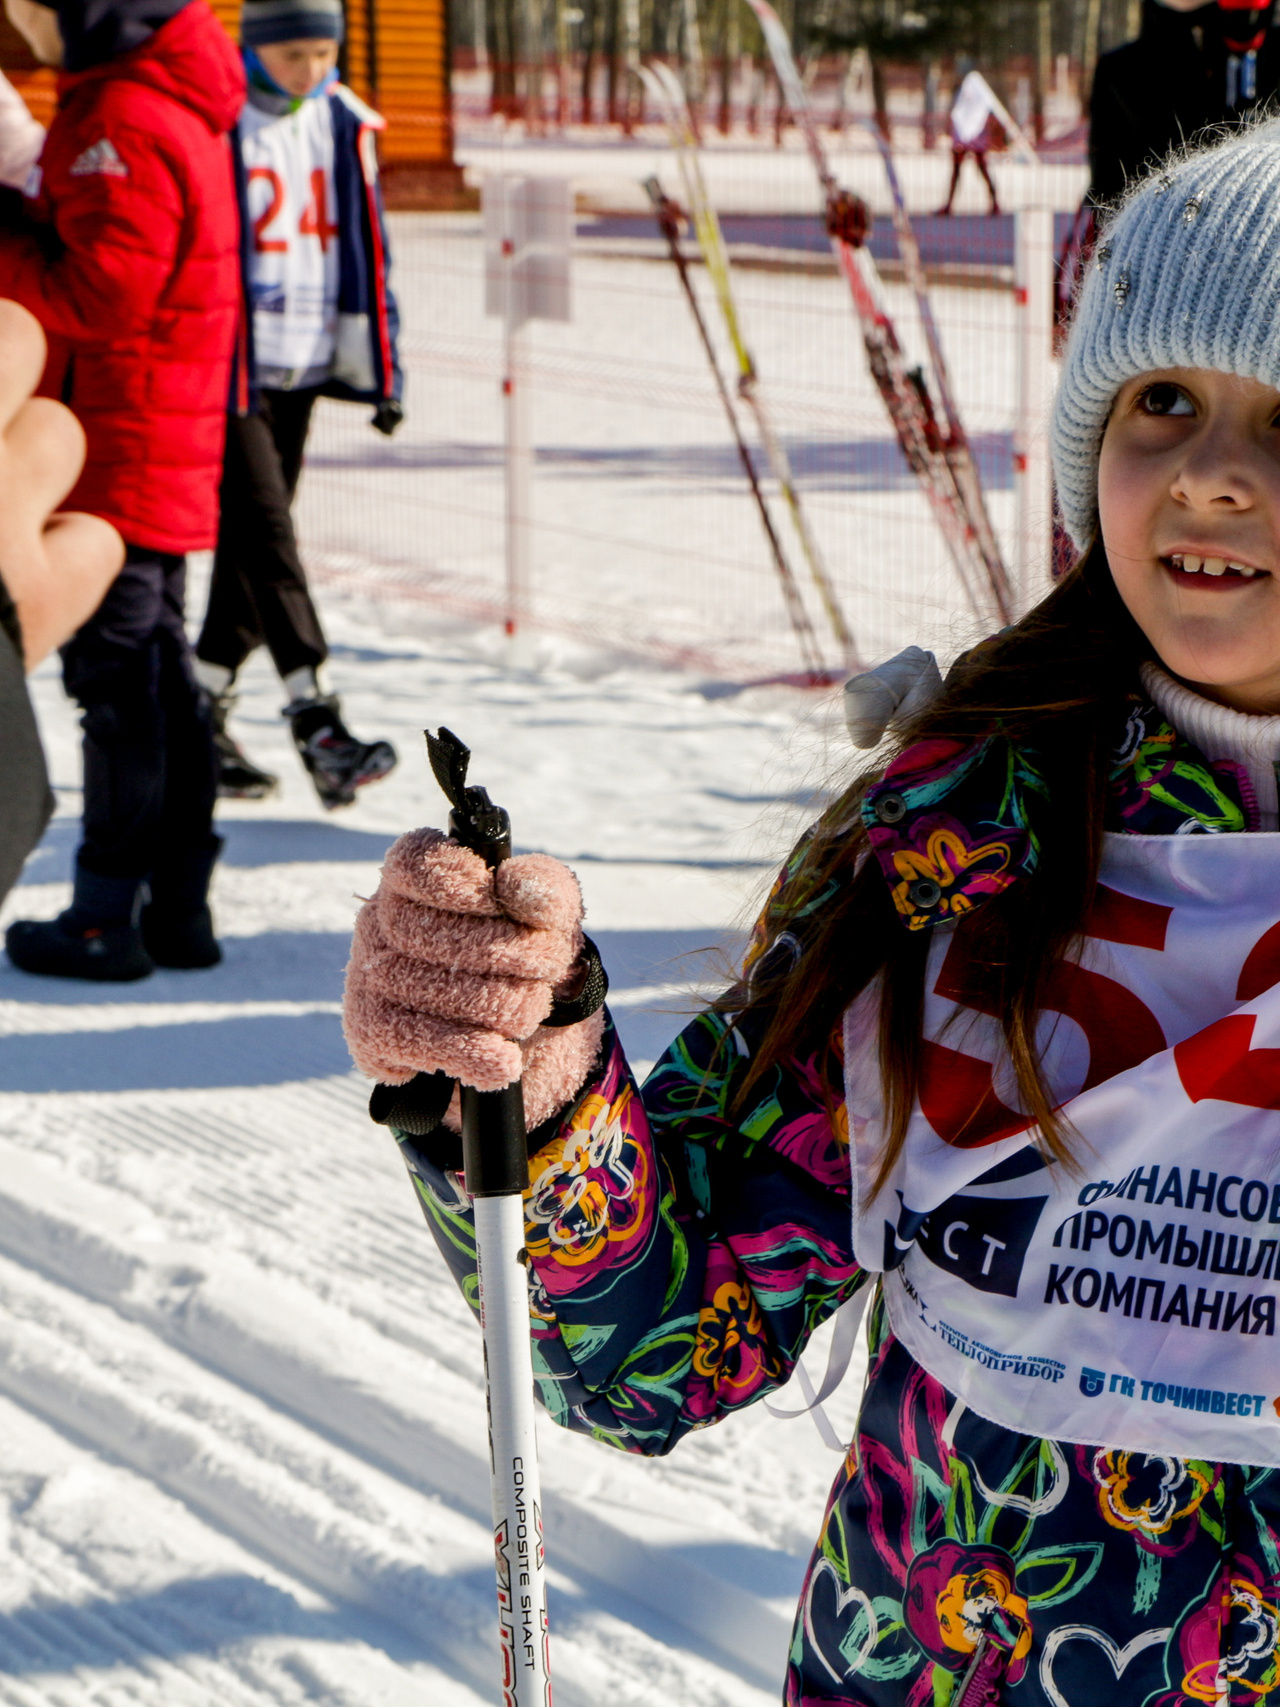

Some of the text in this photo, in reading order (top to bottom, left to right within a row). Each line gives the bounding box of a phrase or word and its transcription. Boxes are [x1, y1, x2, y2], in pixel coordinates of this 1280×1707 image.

[248, 167, 339, 253] 24
[1043, 1263, 1277, 1336] КОМПАНИЯ
[938, 1326, 1066, 1384] ТЕПЛОПРИБОР
[1026, 1355, 1067, 1371] ОБЩЕСТВО
[1108, 1373, 1267, 1417] ГК ТОЧИНВЕСТ
[512, 1456, 536, 1671] COMPOSITE SHAFT
